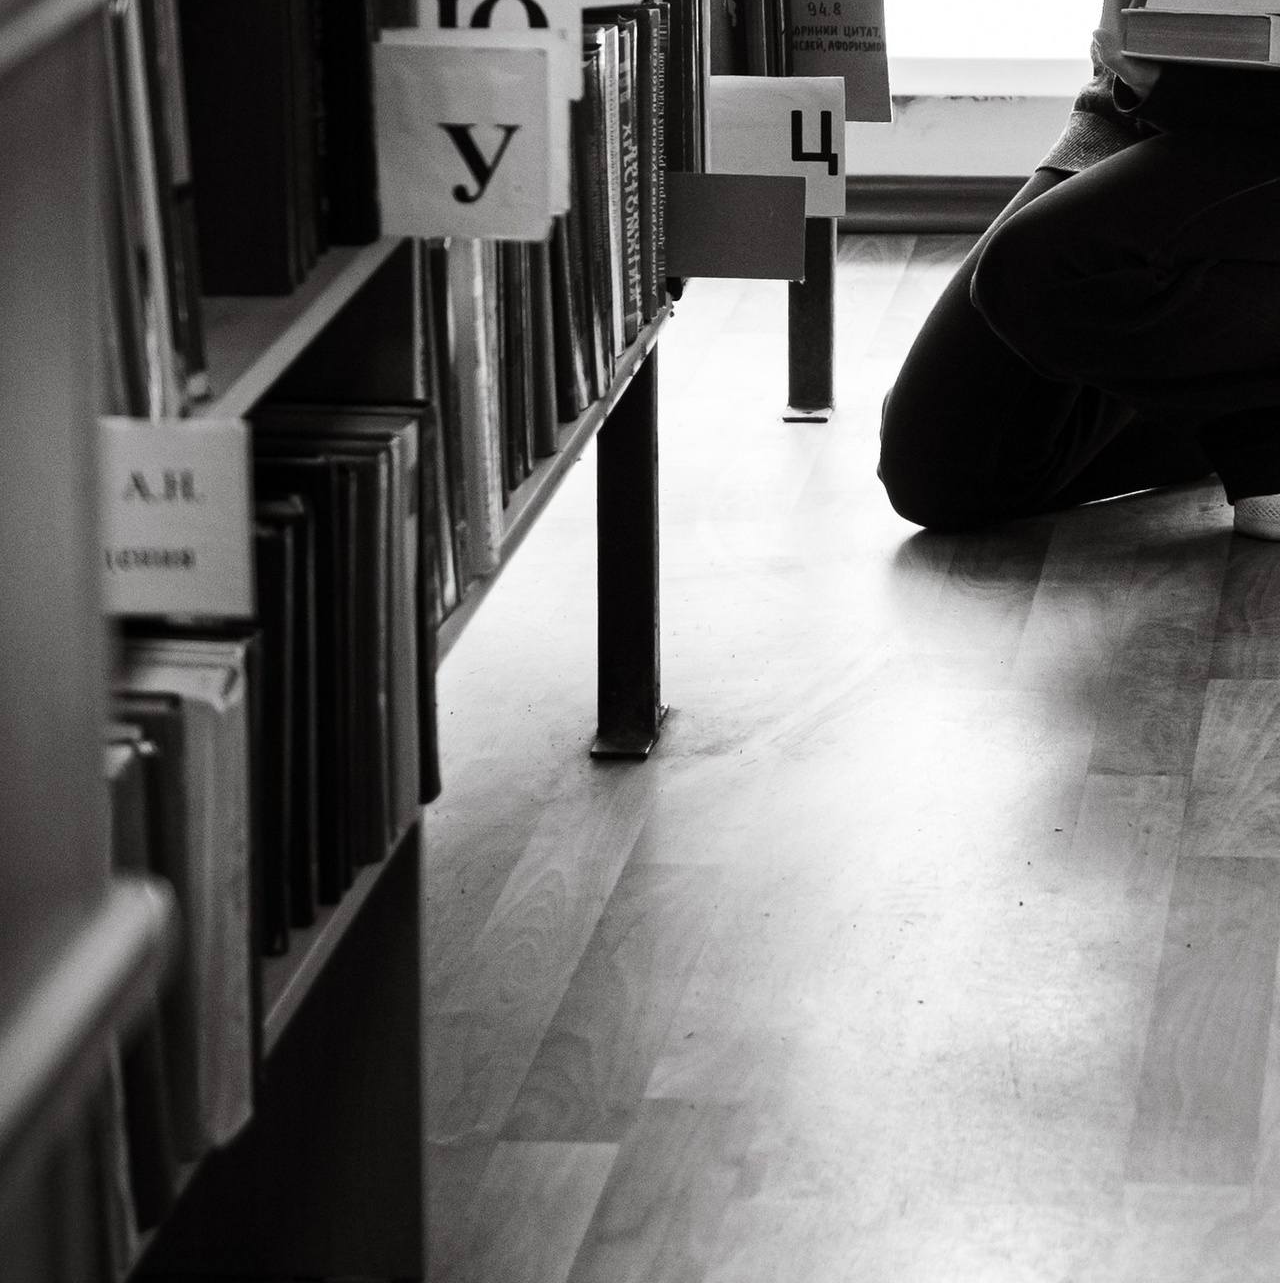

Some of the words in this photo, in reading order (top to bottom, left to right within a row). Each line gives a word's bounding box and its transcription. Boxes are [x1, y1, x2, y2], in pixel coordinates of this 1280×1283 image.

[807, 1, 842, 17] 94.8
[438, 120, 521, 204] У
[791, 109, 839, 176] Ц
